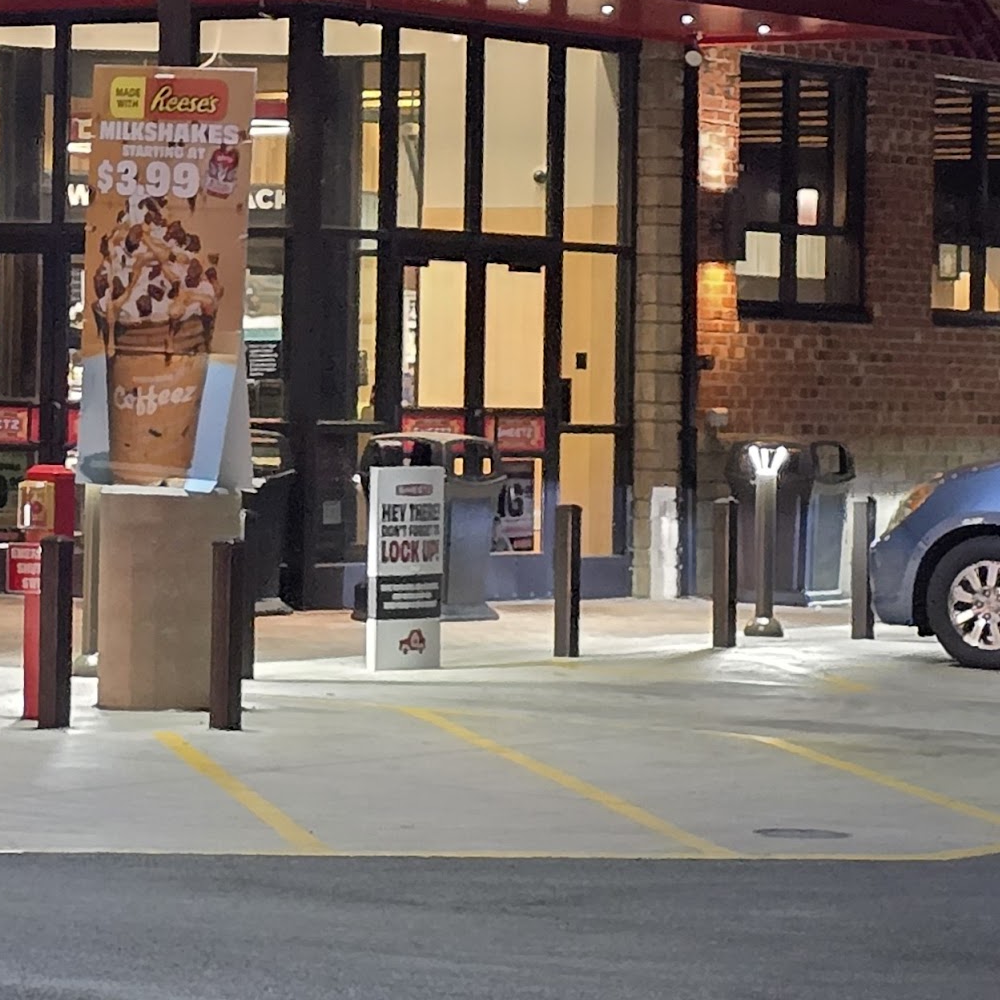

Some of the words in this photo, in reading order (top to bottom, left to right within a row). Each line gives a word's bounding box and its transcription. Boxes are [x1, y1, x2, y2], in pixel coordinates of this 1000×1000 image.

[116, 87, 141, 98] MADE
[100, 120, 239, 145] MILKSHAKES
[122, 144, 185, 159] STARTING
[97, 159, 201, 199] $3.99
[381, 503, 407, 522] HEY
[381, 540, 420, 563] LOCK
